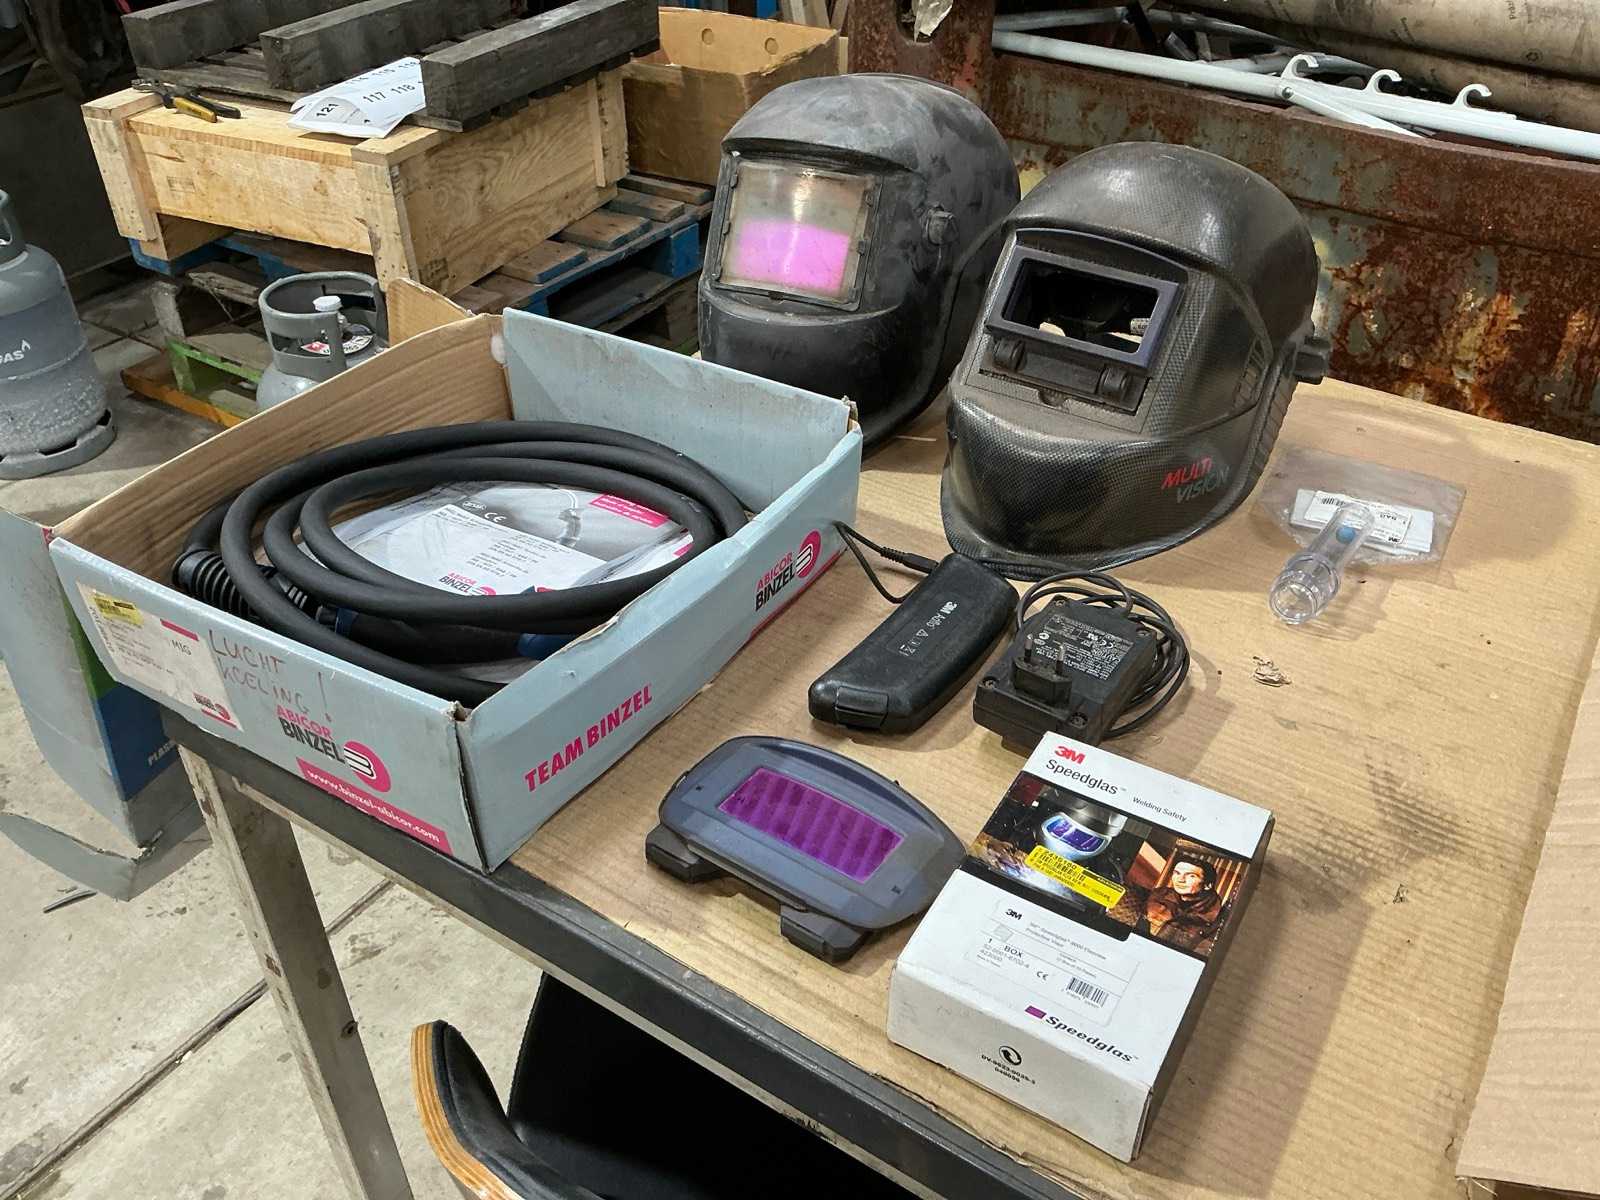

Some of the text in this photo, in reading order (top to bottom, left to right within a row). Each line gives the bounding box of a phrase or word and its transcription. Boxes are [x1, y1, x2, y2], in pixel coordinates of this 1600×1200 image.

[362, 84, 416, 103] 117 118
[316, 103, 340, 117] 121
[1160, 456, 1214, 491] MULTI
[1176, 465, 1231, 504] VISION
[438, 575, 473, 594] BINZEL
[447, 571, 478, 586] ABICOR
[756, 551, 794, 592] ABICOR
[755, 563, 797, 612] BINZEL
[940, 601, 958, 614] 3M
[208, 629, 287, 673] LUCHT
[276, 704, 334, 739] ABICOR
[278, 716, 346, 765] BINZEL
[524, 684, 653, 792] TEAM BINZEL
[1055, 745, 1086, 765] 3M
[306, 769, 440, 843] www.binzel-abicor.com
[1132, 796, 1188, 823] Welding Safety
[1005, 908, 1023, 921] 3M
[1003, 944, 1025, 959] BOX
